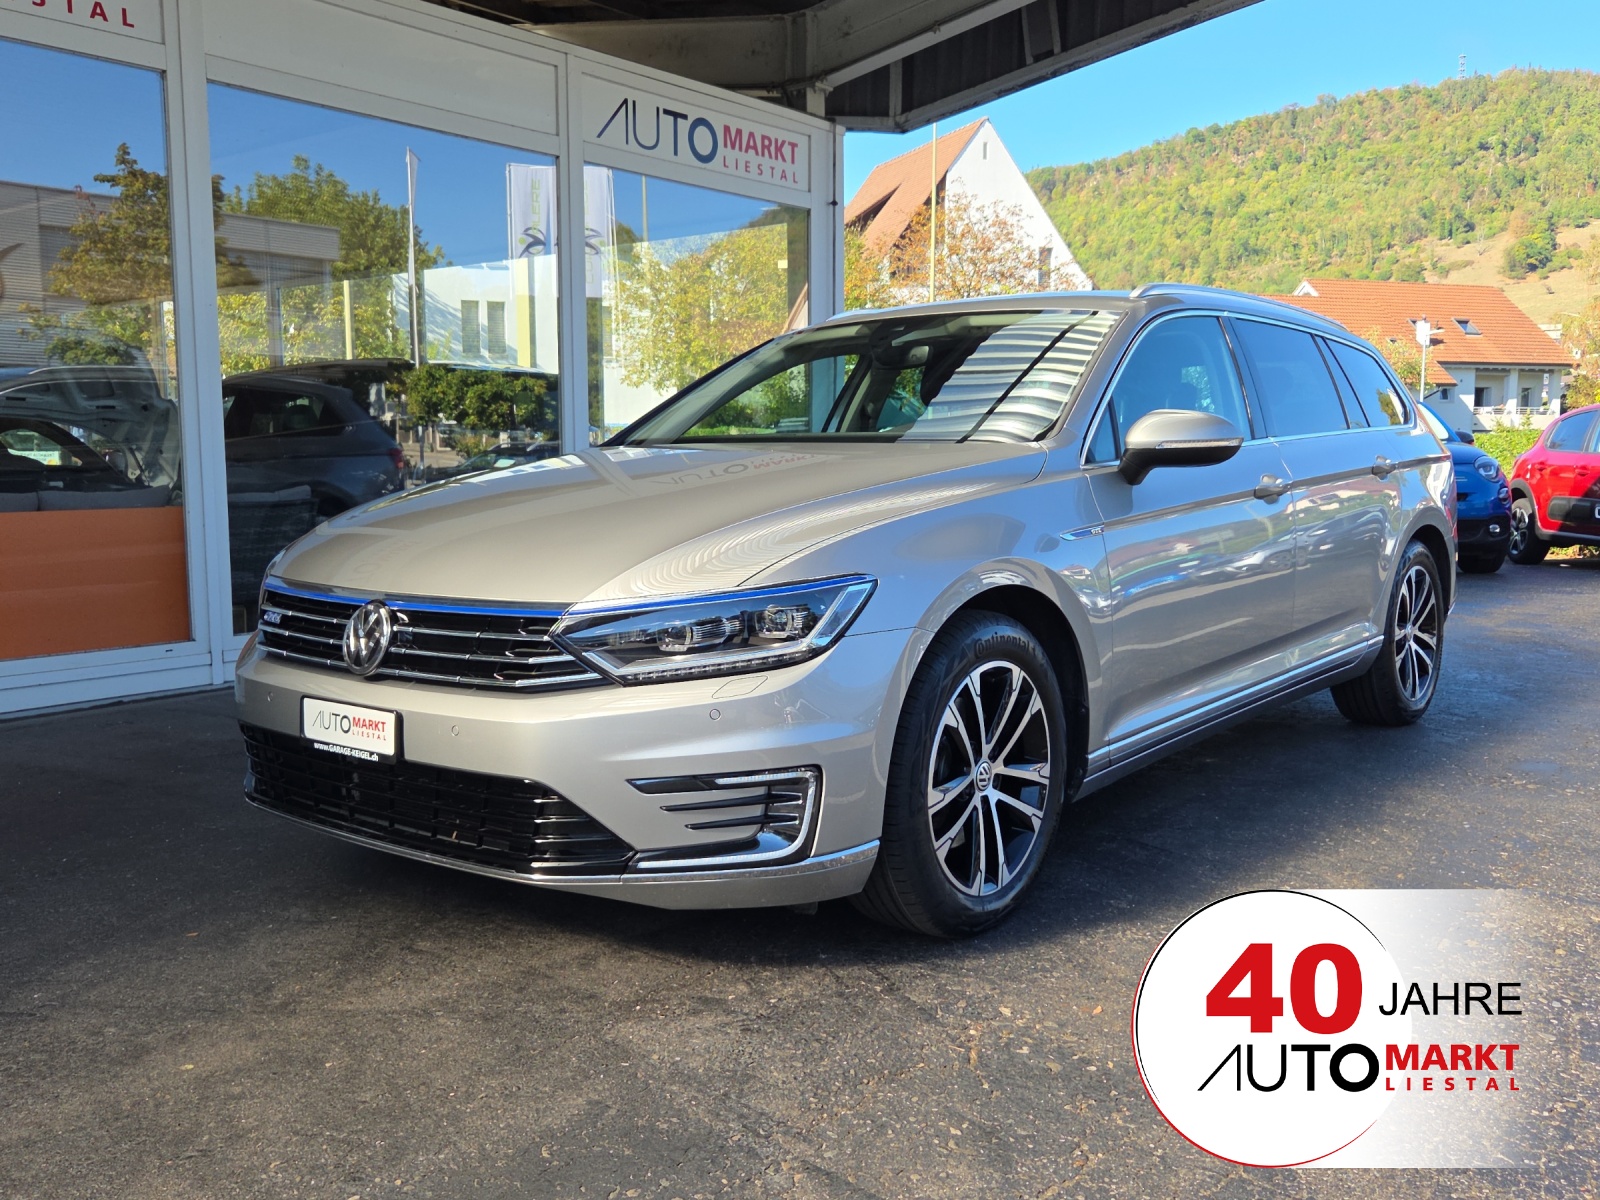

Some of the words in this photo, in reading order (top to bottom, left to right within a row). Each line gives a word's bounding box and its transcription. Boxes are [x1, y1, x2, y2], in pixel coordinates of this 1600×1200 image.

[723, 124, 799, 165] MARKT
[723, 155, 799, 184] LIESTAL
[973, 632, 1031, 659] Continental
[352, 716, 387, 733] MARKT
[352, 730, 387, 741] LIESTAL
